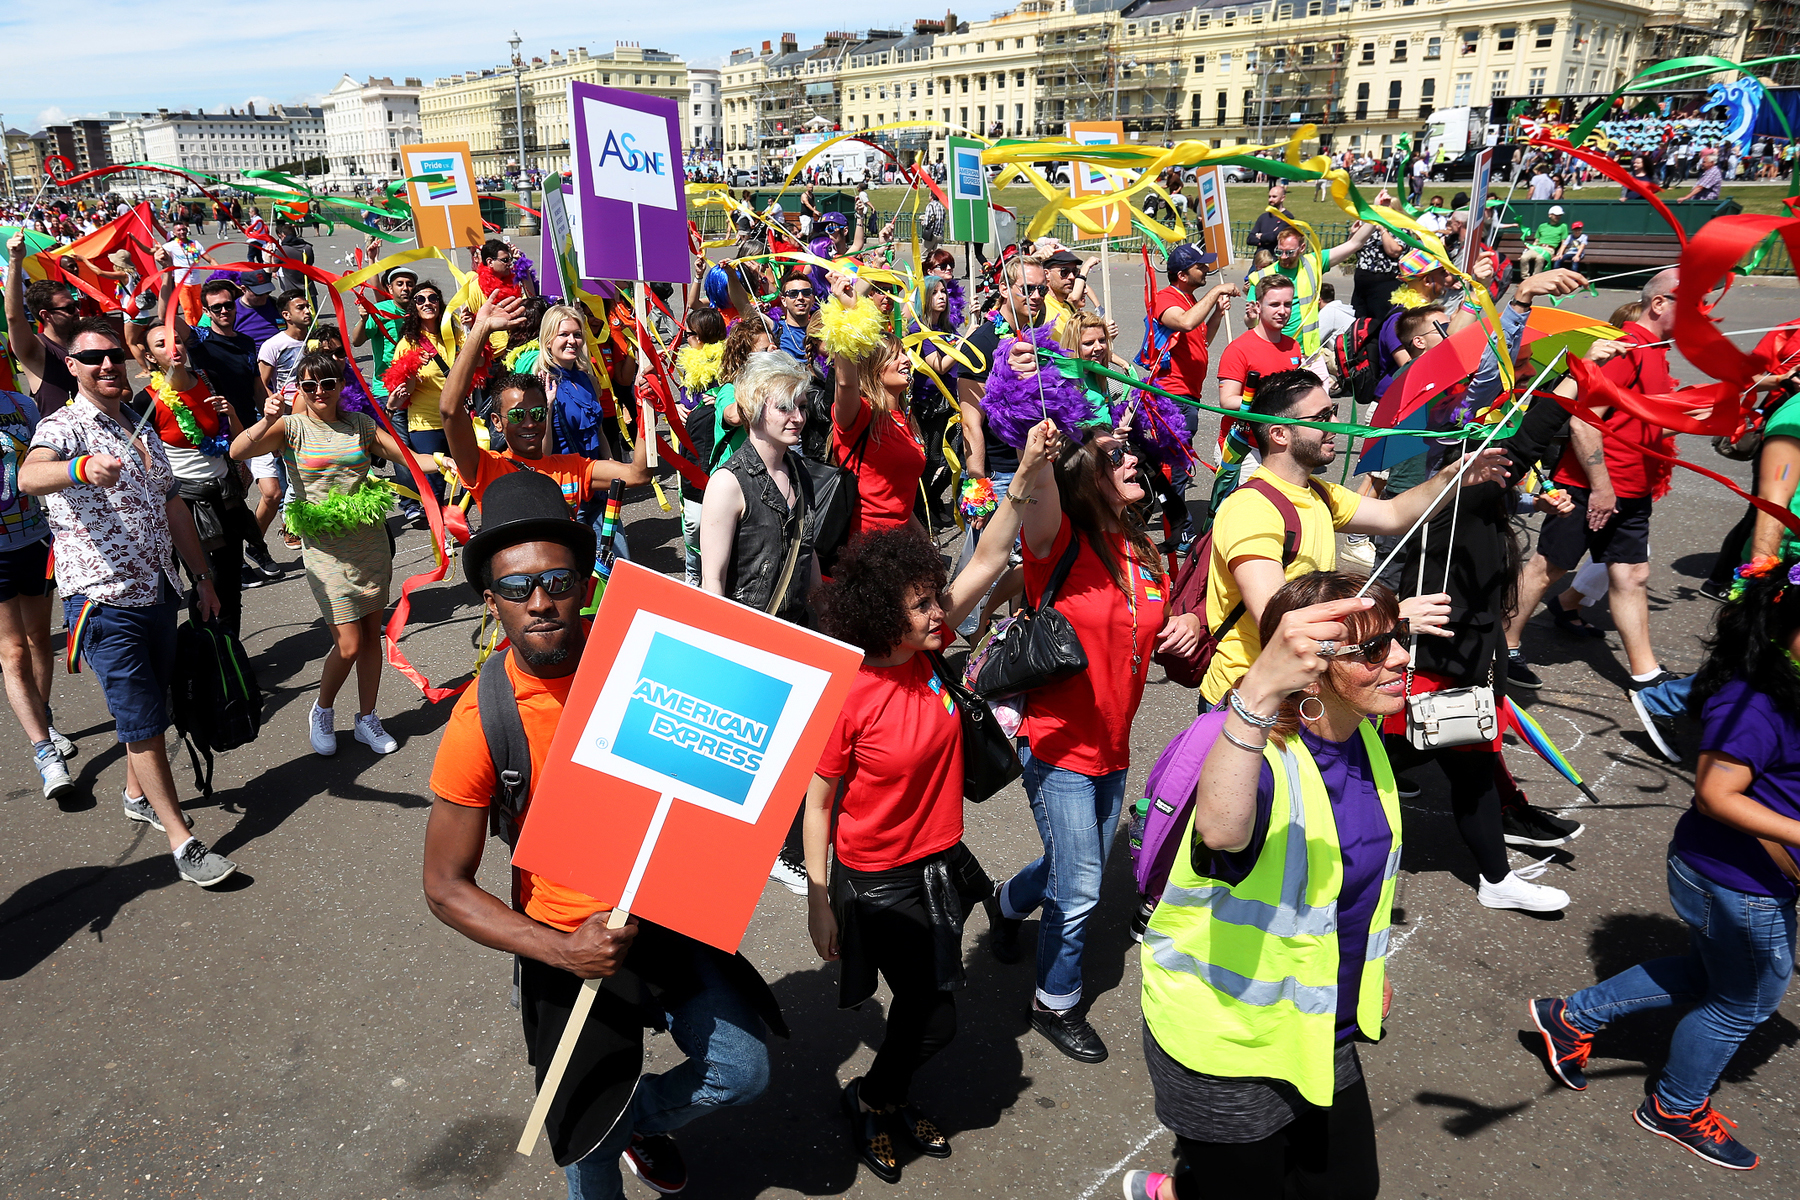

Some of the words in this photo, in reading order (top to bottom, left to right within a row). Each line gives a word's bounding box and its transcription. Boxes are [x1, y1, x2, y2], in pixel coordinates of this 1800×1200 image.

[424, 162, 442, 170] Pride
[959, 168, 979, 177] AMERICAN
[633, 680, 766, 746] AMERICAN
[652, 716, 763, 772] EXPRESS
